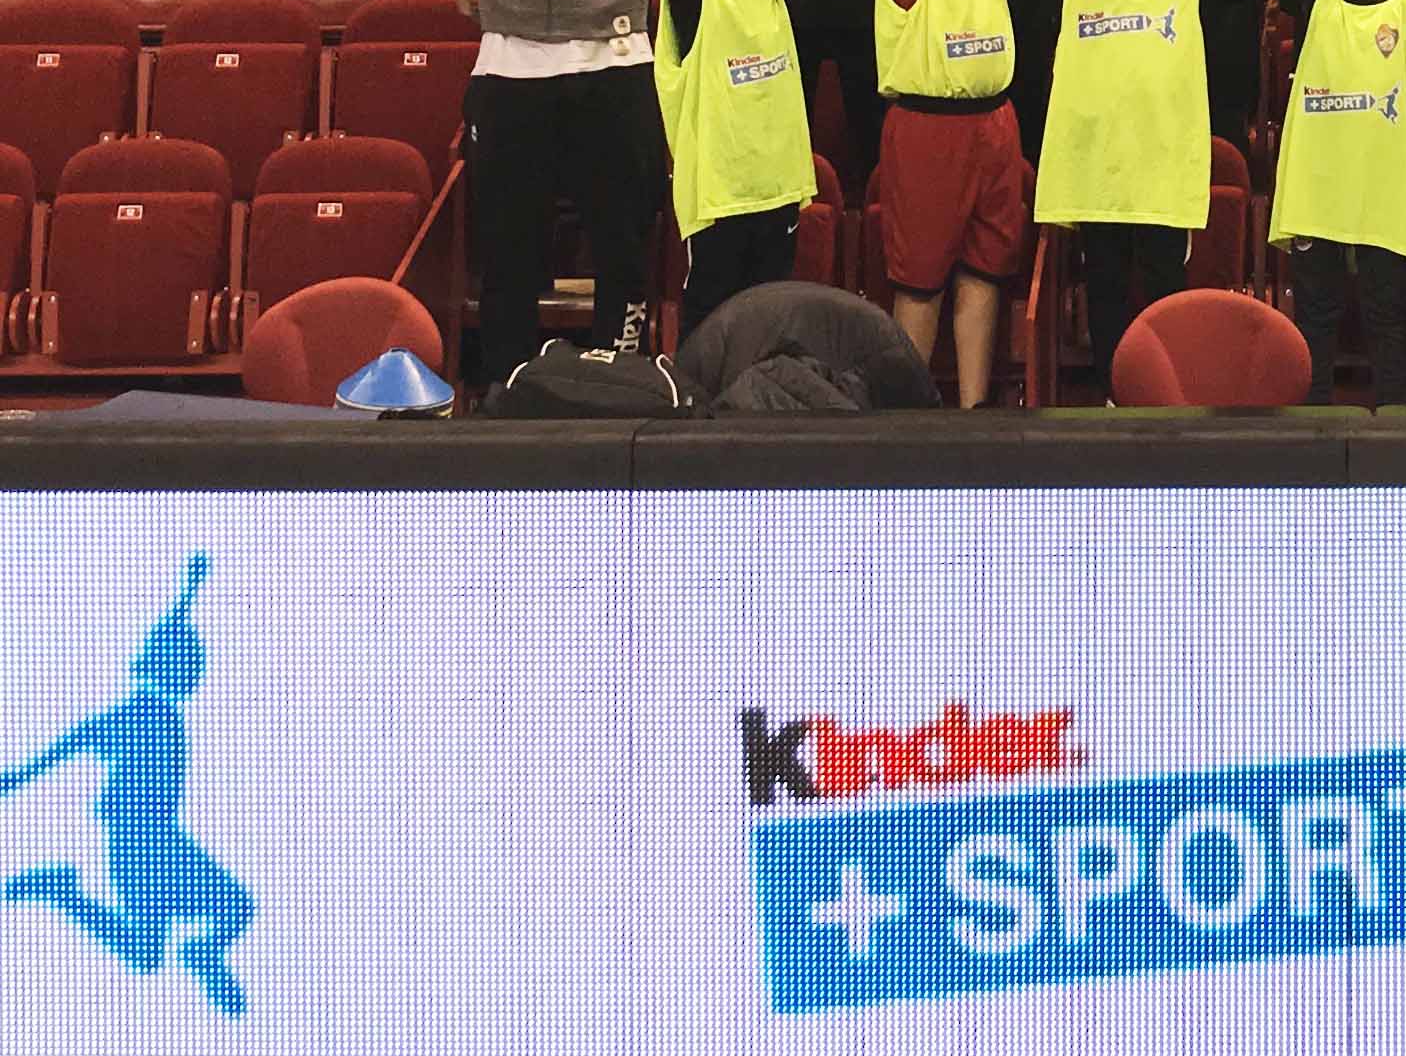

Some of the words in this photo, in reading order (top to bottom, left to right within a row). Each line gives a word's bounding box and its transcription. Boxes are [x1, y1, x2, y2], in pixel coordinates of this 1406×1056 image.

[1095, 17, 1139, 33] SPORT
[1320, 95, 1362, 110] SPORT
[614, 302, 648, 354] Kap
